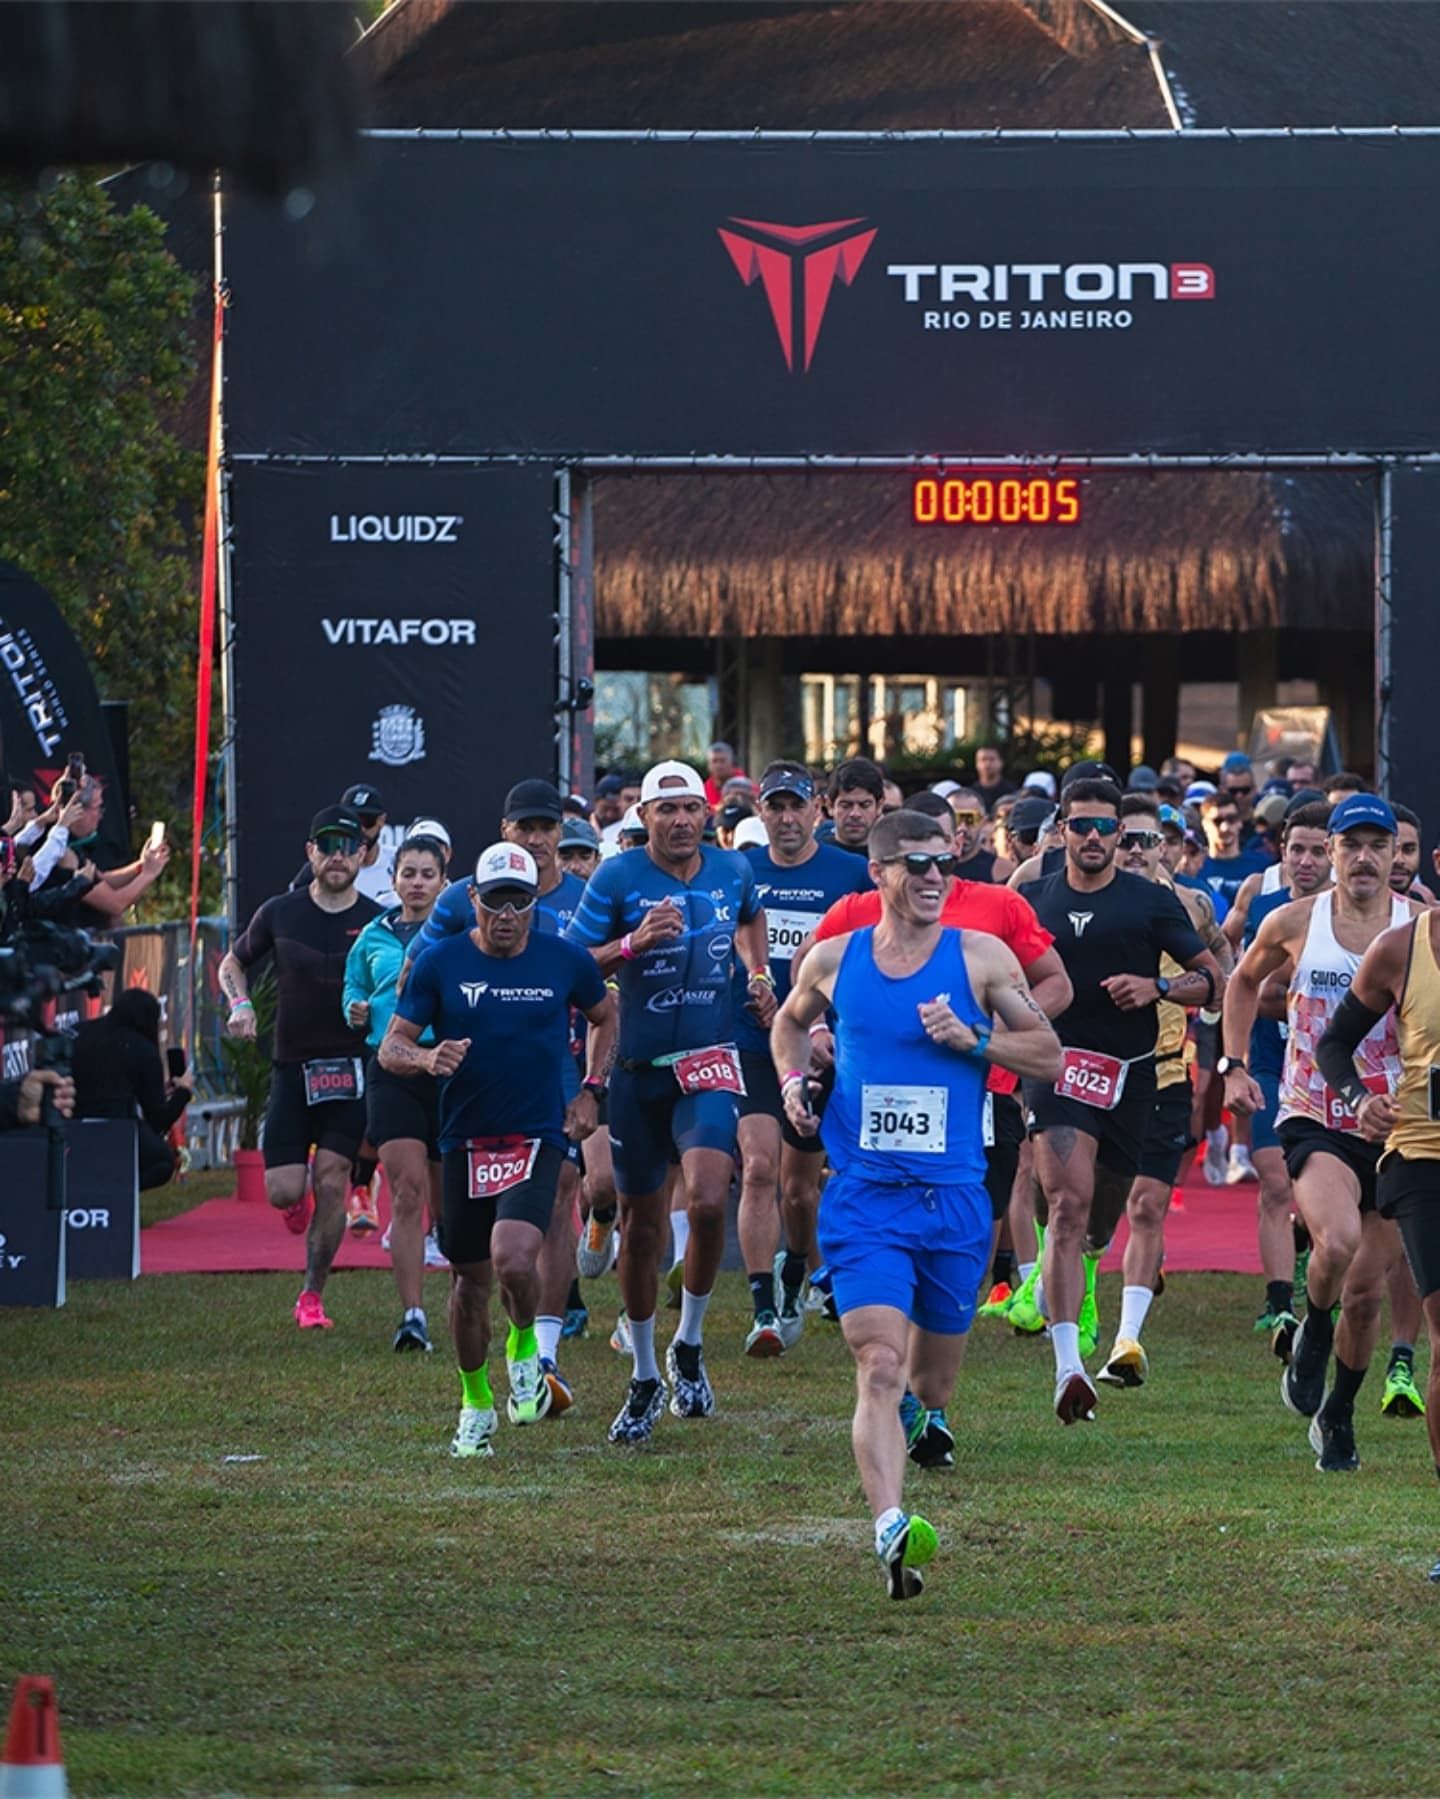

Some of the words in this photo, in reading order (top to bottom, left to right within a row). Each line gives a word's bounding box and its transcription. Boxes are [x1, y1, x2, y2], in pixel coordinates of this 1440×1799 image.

[924, 311, 970, 329] RIO
[979, 311, 1011, 329] DE
[1020, 310, 1132, 329] JANEIRO
[915, 480, 1078, 522] 00:00:05
[321, 619, 477, 645] VITAFOR
[768, 928, 809, 947] 300
[686, 1063, 734, 1082] 6018
[1064, 1065, 1111, 1096] 6023
[869, 1111, 929, 1135] 3043
[476, 1159, 525, 1184] 6020
